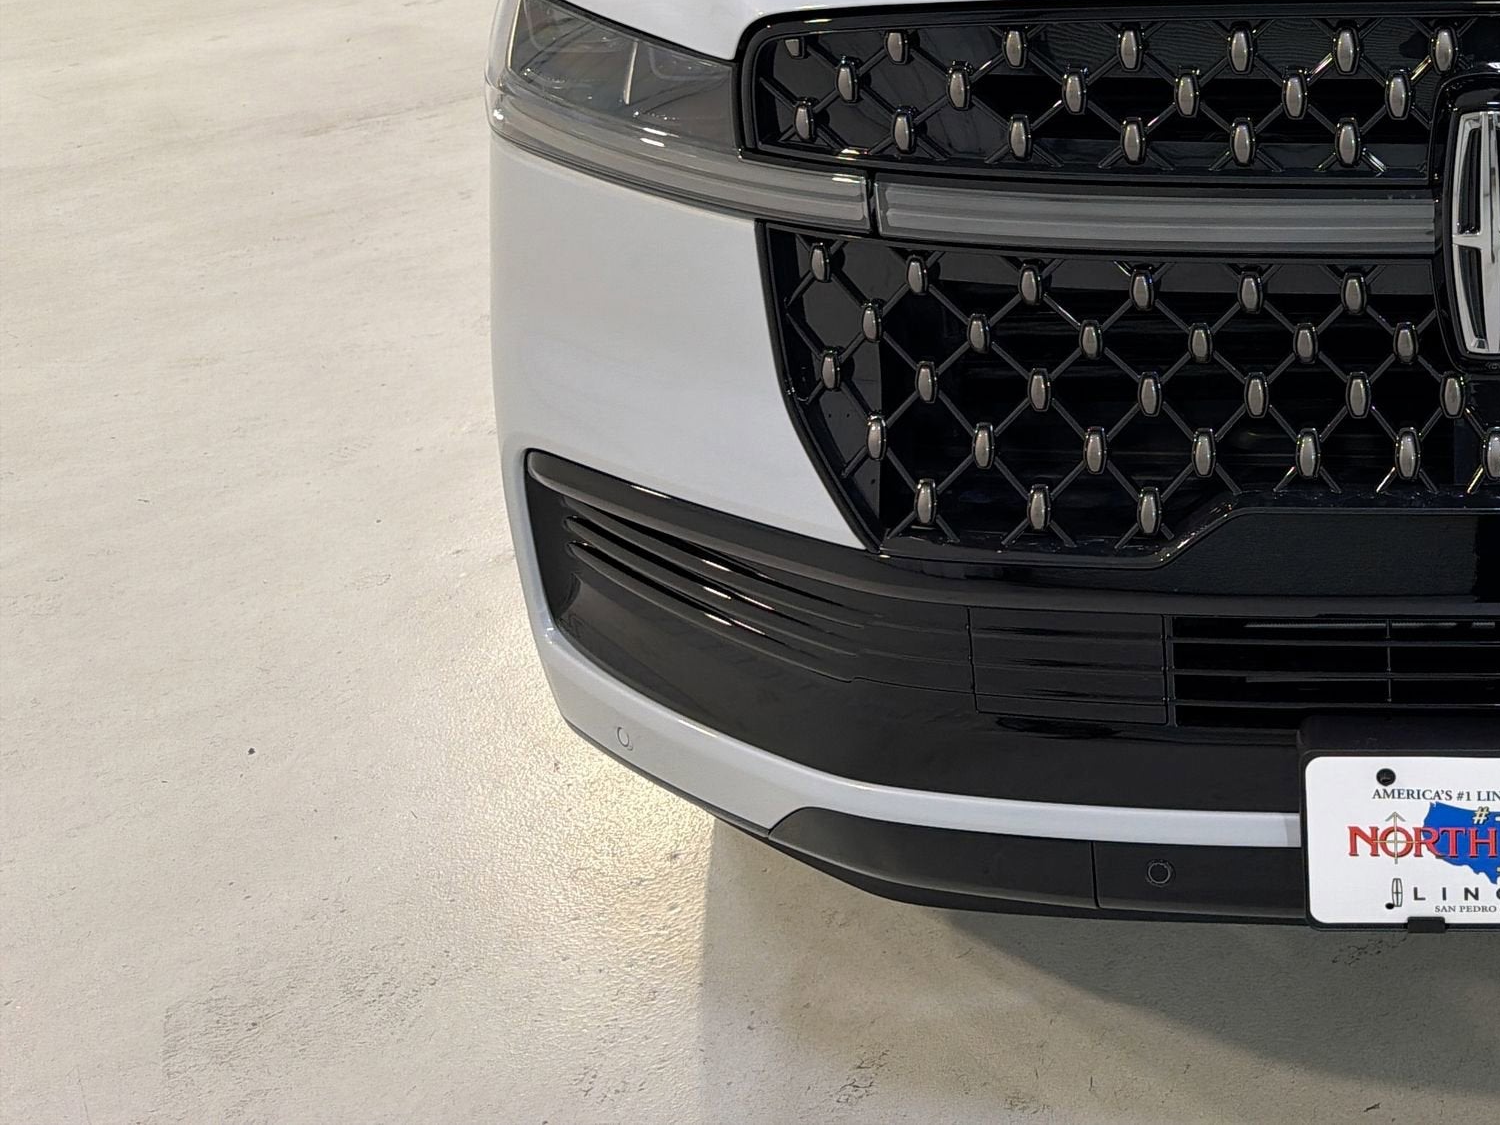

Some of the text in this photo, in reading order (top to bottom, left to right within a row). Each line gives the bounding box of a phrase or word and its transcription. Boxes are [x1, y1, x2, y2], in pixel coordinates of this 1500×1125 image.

[1372, 788, 1453, 801] AMERICA'S
[1456, 790, 1472, 801] #1
[1348, 826, 1497, 858] NORTH
[1434, 905, 1456, 913] SAN
[1459, 905, 1496, 913] PEDRO
